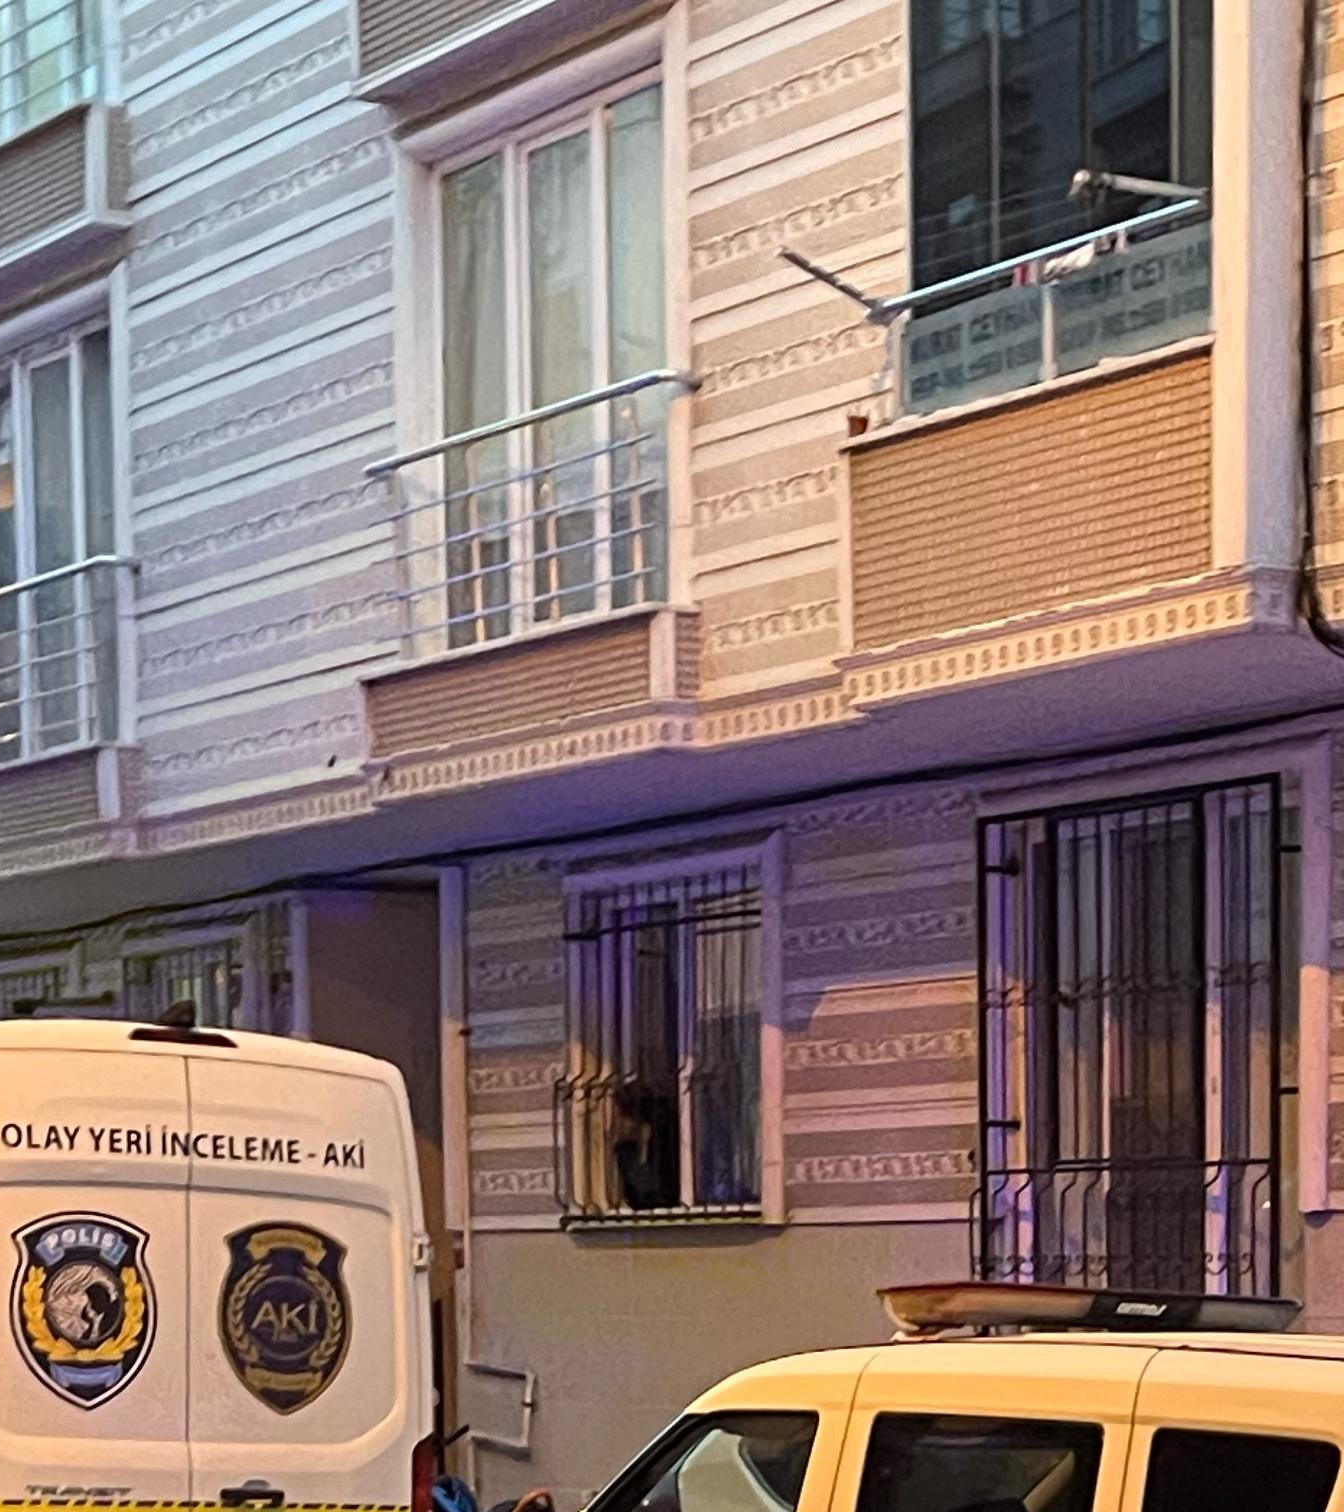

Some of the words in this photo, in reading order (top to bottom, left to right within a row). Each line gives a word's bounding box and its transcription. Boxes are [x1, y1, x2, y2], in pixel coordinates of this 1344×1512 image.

[1, 1123, 80, 1151] OLAY
[89, 1124, 152, 1155] YERİ
[161, 1125, 301, 1164] İNCELEME
[323, 1139, 366, 1169] AKİ
